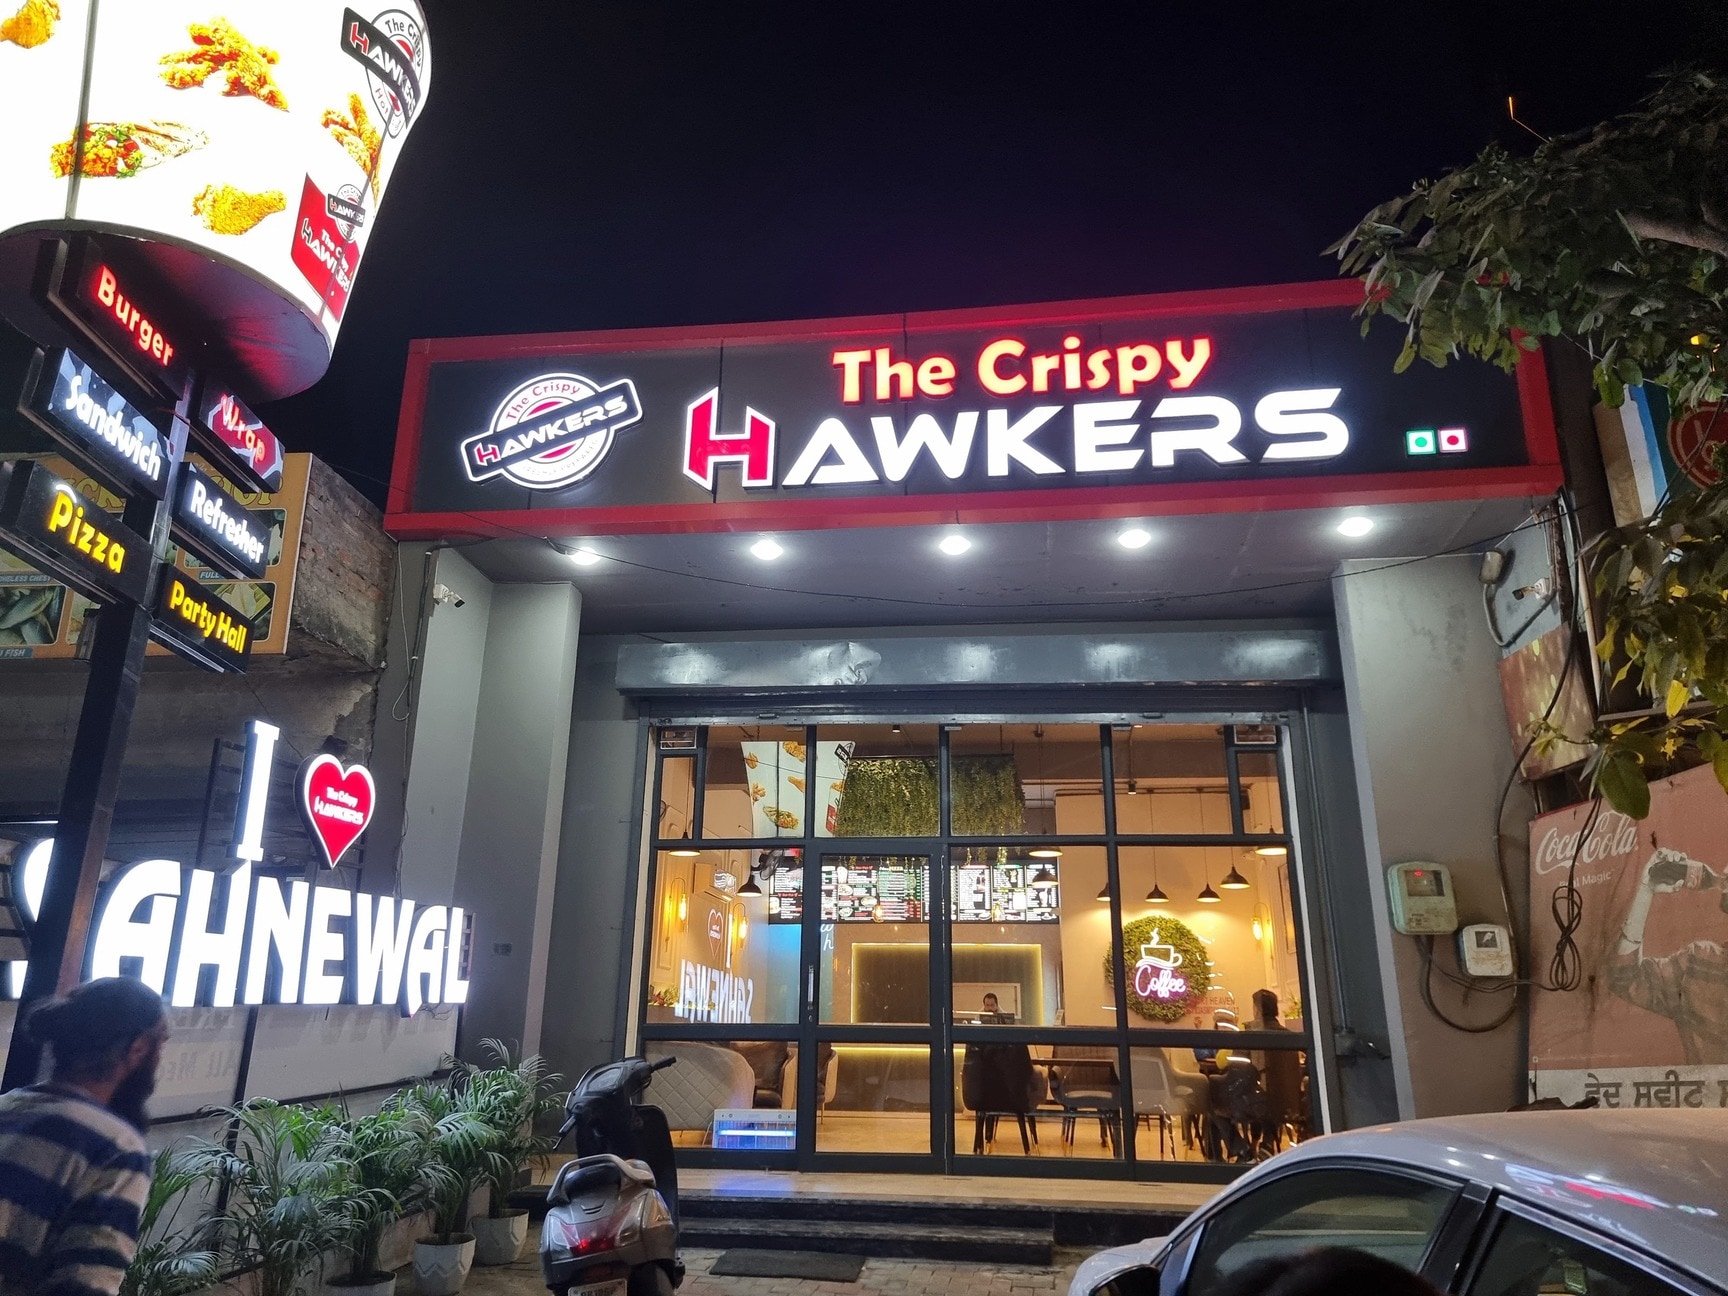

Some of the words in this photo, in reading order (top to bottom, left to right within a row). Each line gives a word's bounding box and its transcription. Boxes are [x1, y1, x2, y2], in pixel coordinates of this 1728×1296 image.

[385, 18, 404, 34] The
[97, 265, 174, 366] Burger
[506, 397, 529, 420] The
[532, 381, 581, 396] Crispy
[832, 350, 955, 403] The
[977, 336, 1212, 397] Crispy
[65, 374, 161, 481] Sandwich
[221, 394, 265, 463] Wrap
[474, 394, 629, 467] HAWKERS
[682, 385, 1350, 492] HAWKERS
[48, 489, 126, 574] Pizza
[190, 479, 264, 564] Refresher
[4, 649, 26, 657] FISH
[169, 580, 217, 638] Party
[216, 612, 248, 654] Hall
[1136, 965, 1186, 998] Coffee
